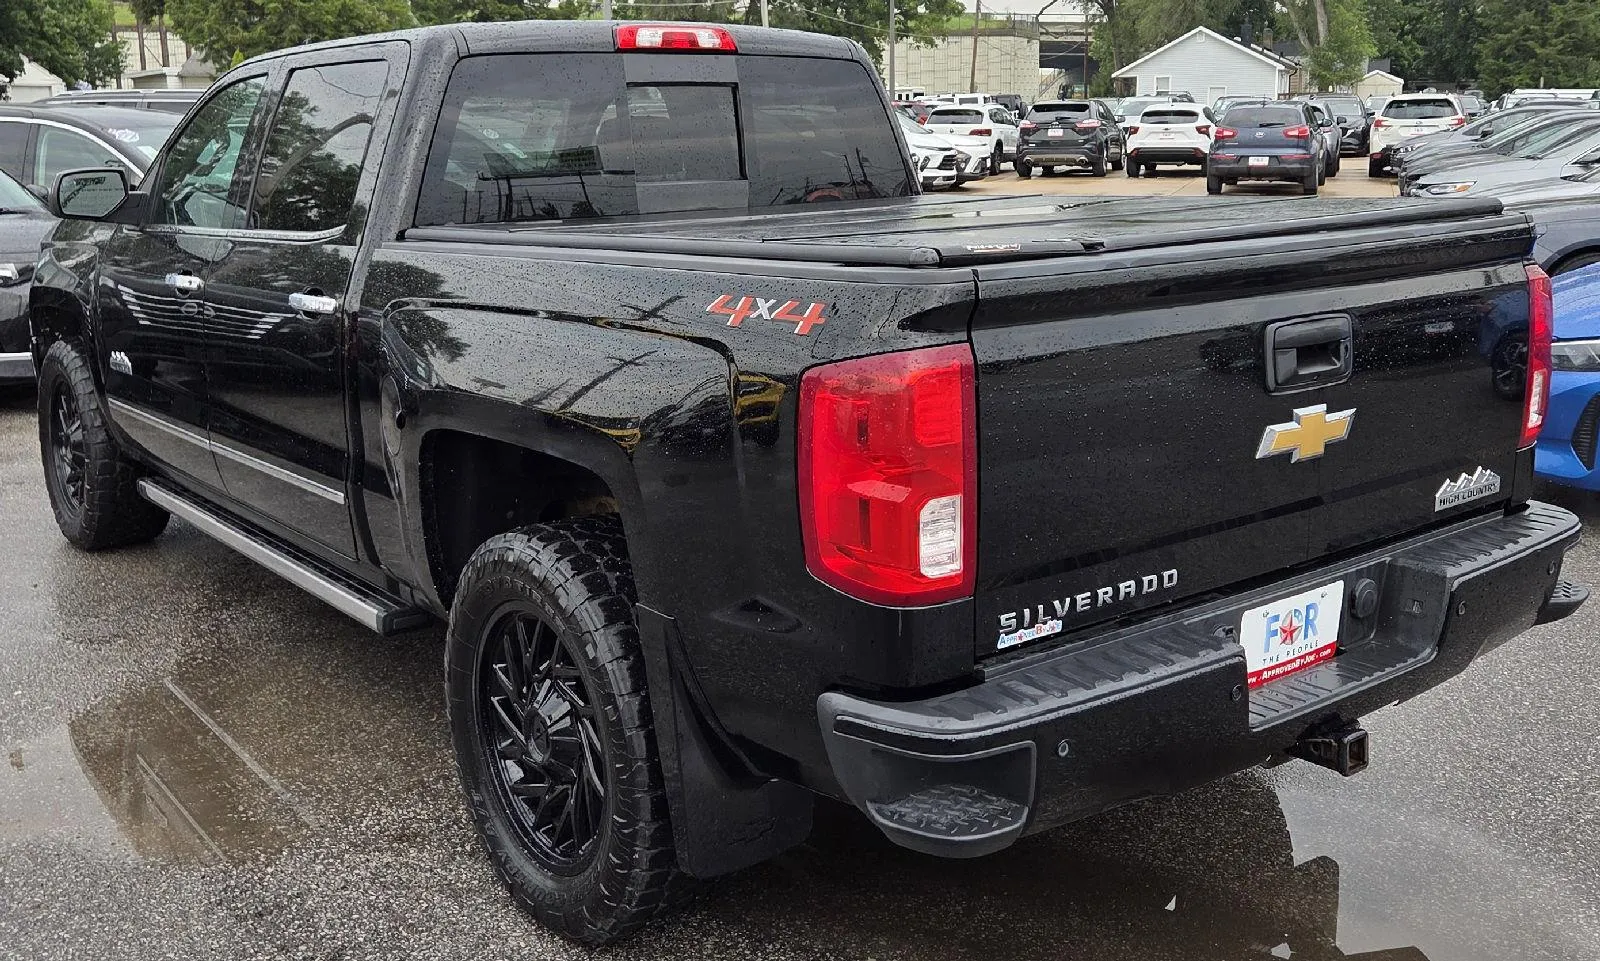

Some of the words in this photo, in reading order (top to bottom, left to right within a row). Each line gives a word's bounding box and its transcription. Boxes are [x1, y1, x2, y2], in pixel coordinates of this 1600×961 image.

[1439, 494, 1460, 506] HIGH
[1463, 483, 1497, 500] COUNTRY
[998, 568, 1178, 633] SILVERADO
[1262, 654, 1281, 666] THE
[1286, 639, 1320, 657] PEOPLE
